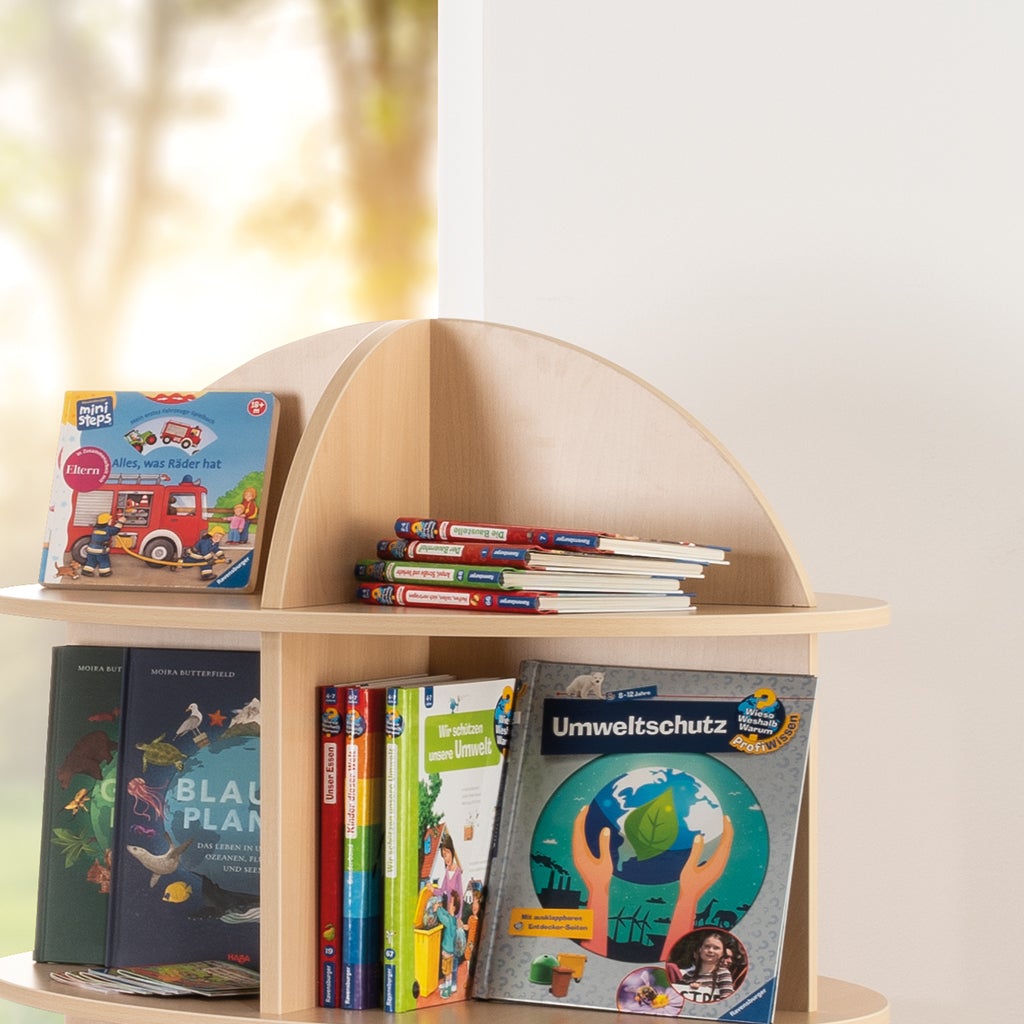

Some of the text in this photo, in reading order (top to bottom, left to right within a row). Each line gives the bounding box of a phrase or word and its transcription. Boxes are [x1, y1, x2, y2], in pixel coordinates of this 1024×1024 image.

[80, 402, 108, 416] mini
[78, 413, 112, 427] steps
[66, 464, 100, 475] Eltern
[112, 458, 141, 470] Alles,
[143, 461, 166, 469] was
[168, 458, 200, 470] Räder
[202, 459, 223, 470] hat
[454, 528, 490, 538] Baustelle
[491, 530, 505, 538] Die
[556, 536, 590, 546] Ravensburger
[450, 546, 461, 554] Der
[216, 556, 250, 584] Ravensburger
[499, 598, 530, 607] Ravensburger
[78, 664, 100, 672] MOIRA
[152, 668, 236, 678] MOIRA BUTTERFIELD
[618, 690, 651, 699] 8-12 Jahre
[745, 708, 775, 719] Wieso
[552, 715, 728, 737] Umweltschutz
[738, 714, 778, 728] Weshalb
[439, 723, 484, 738] Wir schützen
[739, 722, 774, 735] Warum
[428, 736, 492, 762] unsere Umwelt
[326, 746, 334, 800] Unser Essen
[197, 842, 213, 850] DAS
[205, 854, 248, 862] OZEANEN,
[344, 966, 352, 1004] Ravensburger
[730, 988, 767, 1016] Ravensburger
